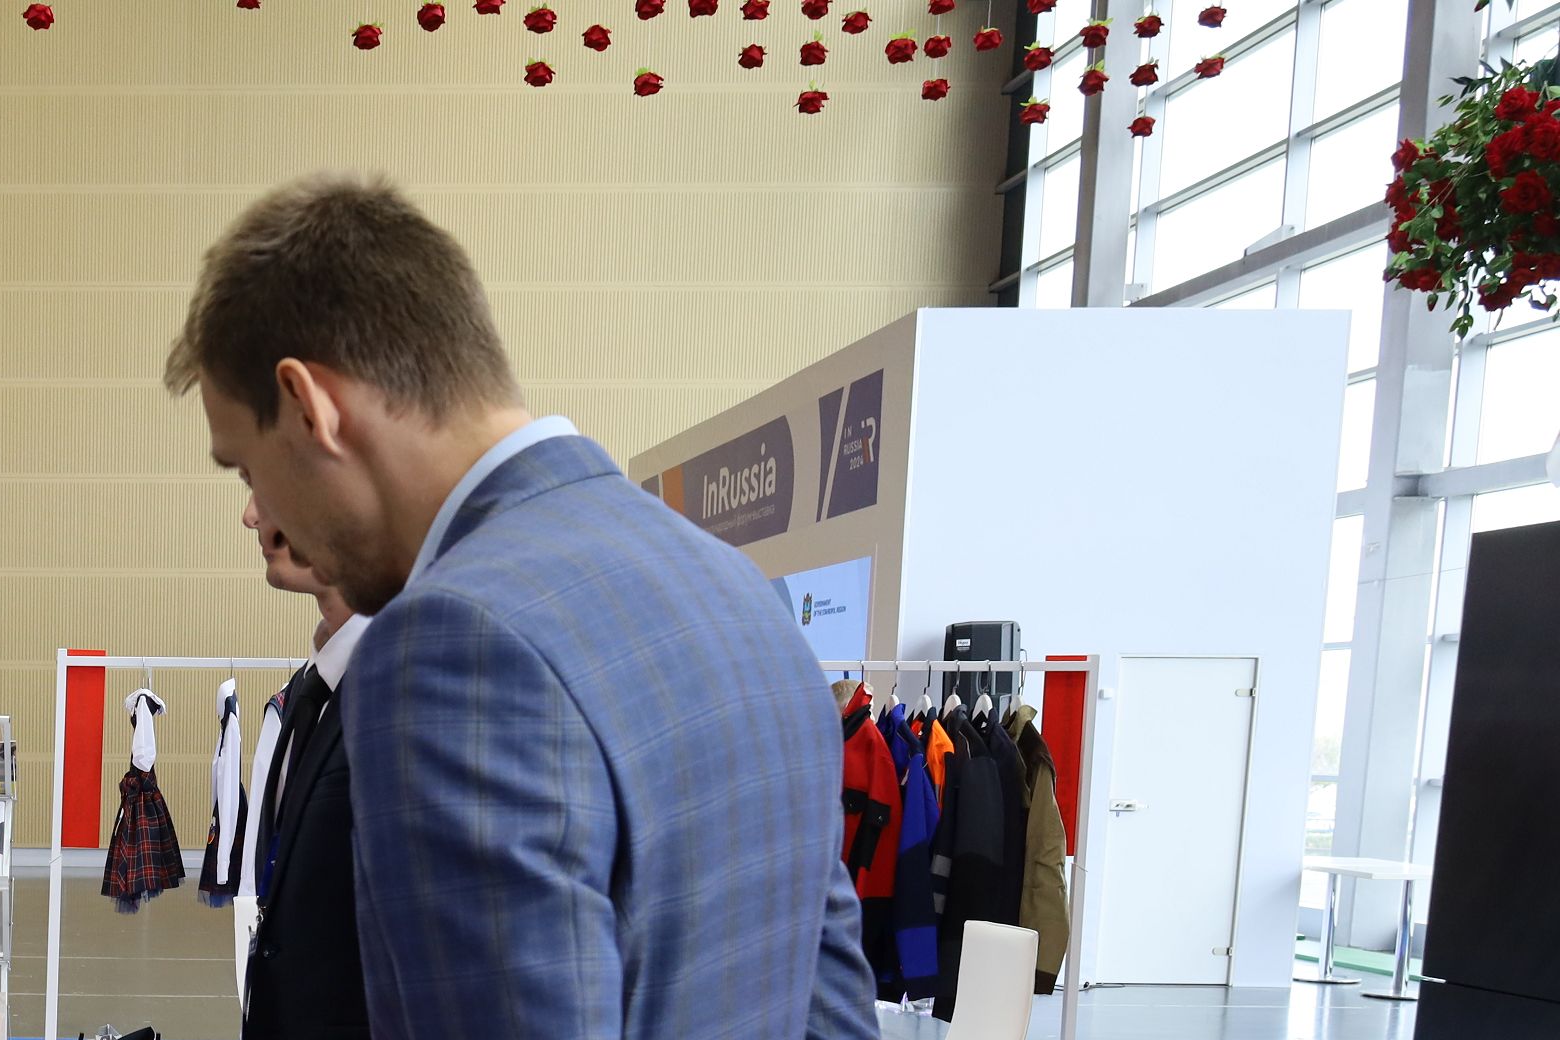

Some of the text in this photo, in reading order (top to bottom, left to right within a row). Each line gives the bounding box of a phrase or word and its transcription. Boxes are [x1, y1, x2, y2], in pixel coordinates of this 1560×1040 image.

[843, 426, 853, 439] IN
[843, 439, 862, 456] RUSSIA
[849, 455, 864, 470] 2024
[702, 442, 777, 520] InRussia
